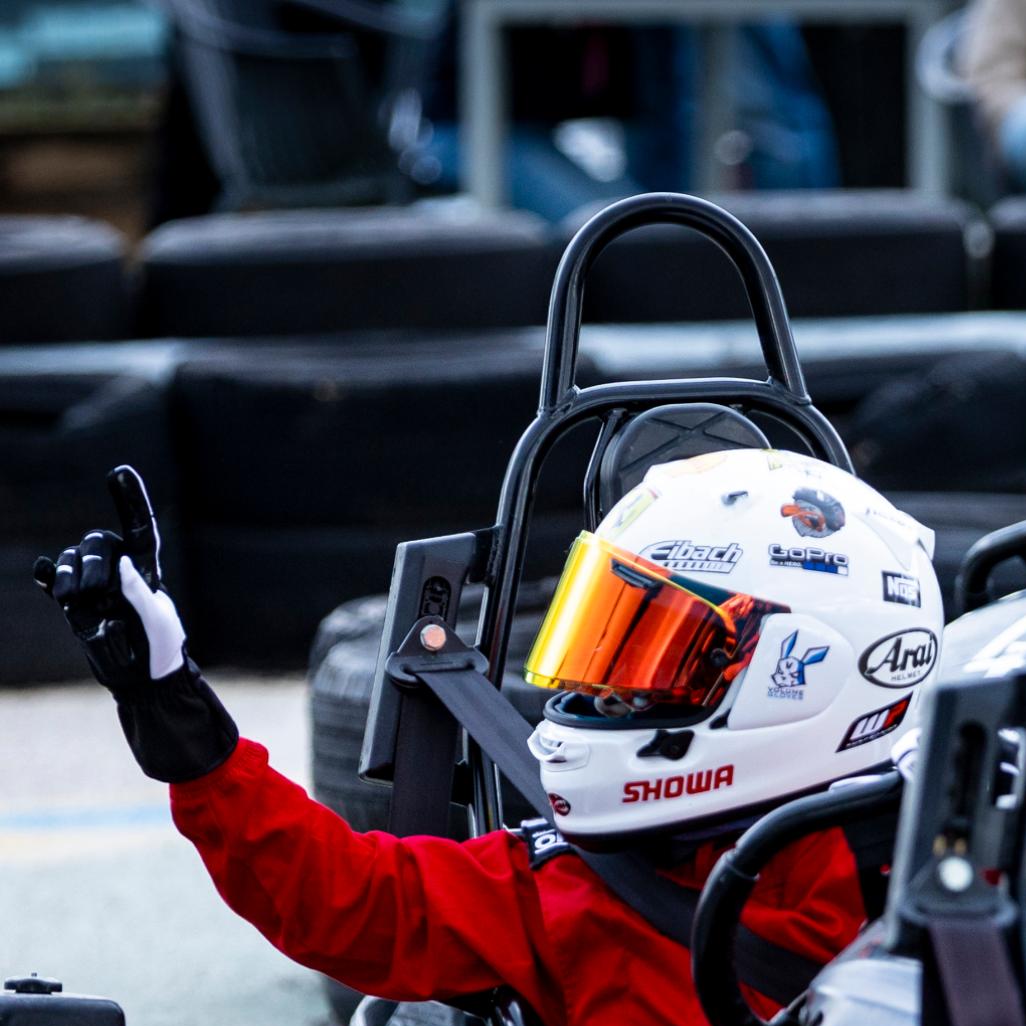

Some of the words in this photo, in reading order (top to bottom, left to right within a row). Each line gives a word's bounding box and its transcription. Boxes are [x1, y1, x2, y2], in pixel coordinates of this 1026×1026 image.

[639, 540, 743, 563] Eibach
[768, 544, 848, 566] GoPro
[866, 631, 933, 673] Arai
[622, 764, 734, 803] SHOWA
